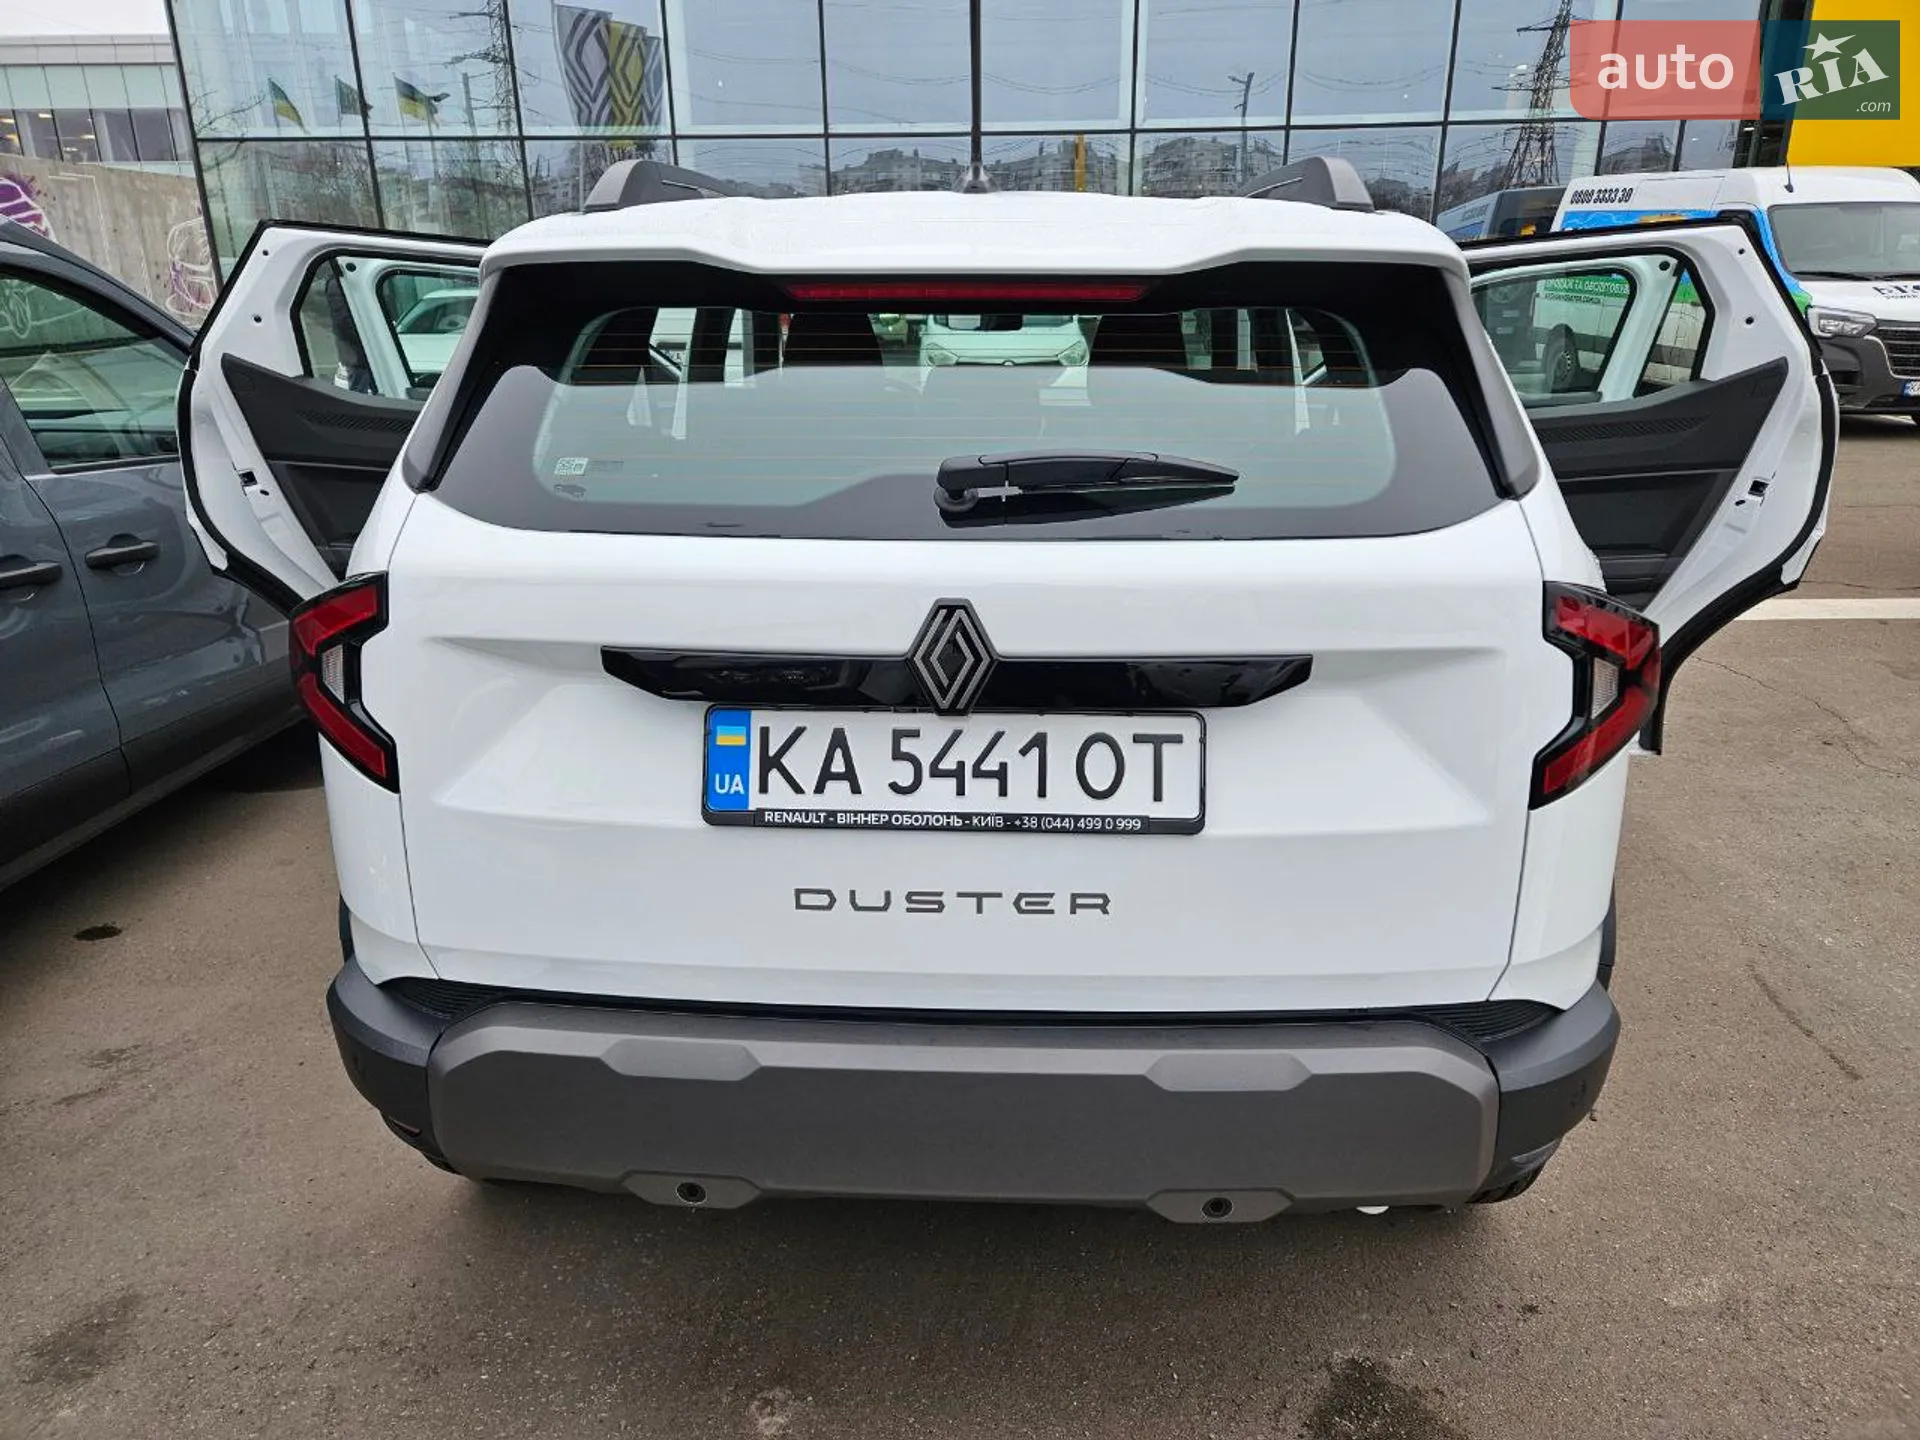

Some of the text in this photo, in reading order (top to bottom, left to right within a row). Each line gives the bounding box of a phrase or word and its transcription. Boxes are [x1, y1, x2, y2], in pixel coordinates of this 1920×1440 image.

[1593, 188, 1619, 204] 3333
[1618, 187, 1633, 203] 30
[758, 726, 1184, 802] KA 5441 OT
[715, 773, 744, 794] UA
[764, 811, 827, 824] RENAULT
[836, 812, 889, 825] ВІННЕР
[891, 813, 963, 827] ОБОЛОНЬ
[972, 812, 1004, 828] КИЇВ
[1014, 816, 1038, 829] +38
[1040, 817, 1074, 831] (044)
[1077, 817, 1102, 830] 499
[1105, 817, 1113, 830] 0
[1116, 817, 1141, 831] 999
[794, 888, 1112, 916] DUSTER
